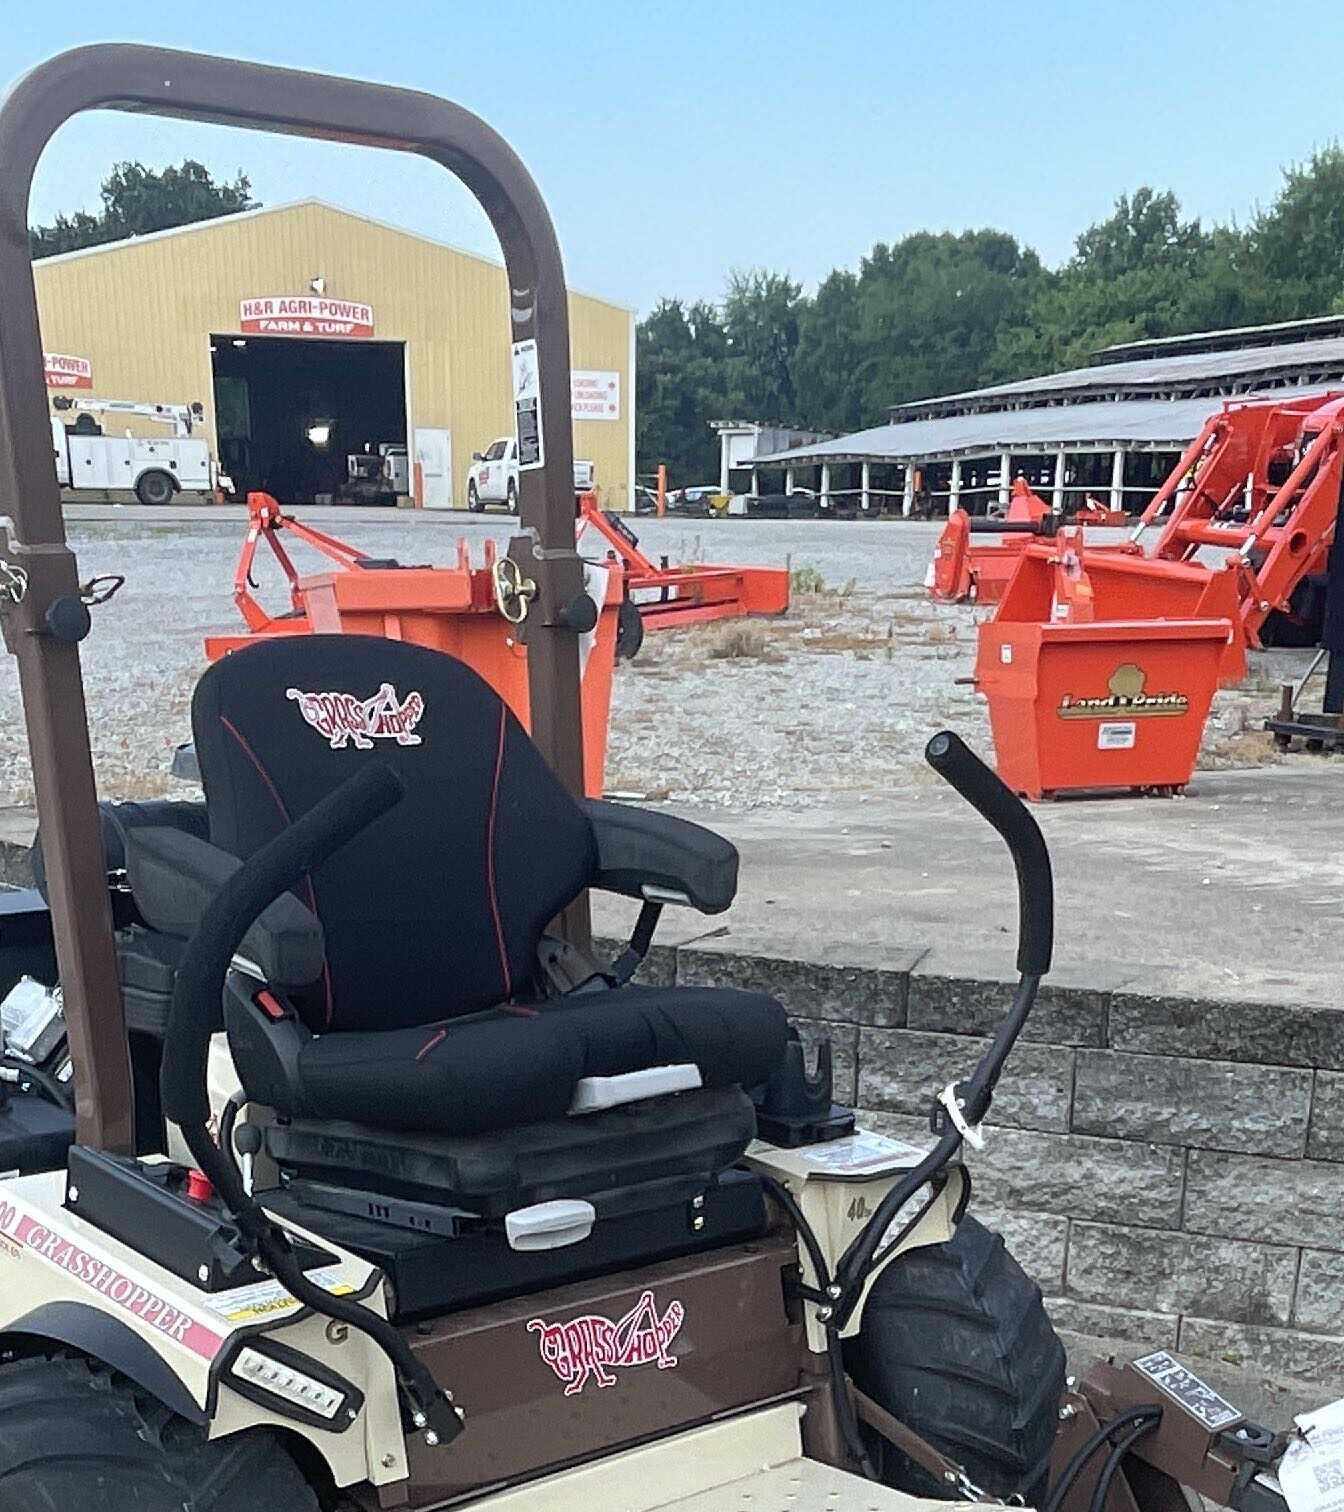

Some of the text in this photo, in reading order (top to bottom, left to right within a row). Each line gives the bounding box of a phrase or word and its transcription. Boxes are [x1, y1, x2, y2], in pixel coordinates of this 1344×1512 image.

[243, 300, 370, 322] H&R AGRI-POWER
[259, 320, 300, 332] FARM
[316, 322, 354, 334] TURF
[26, 1224, 193, 1344] GRASSHOPPER
